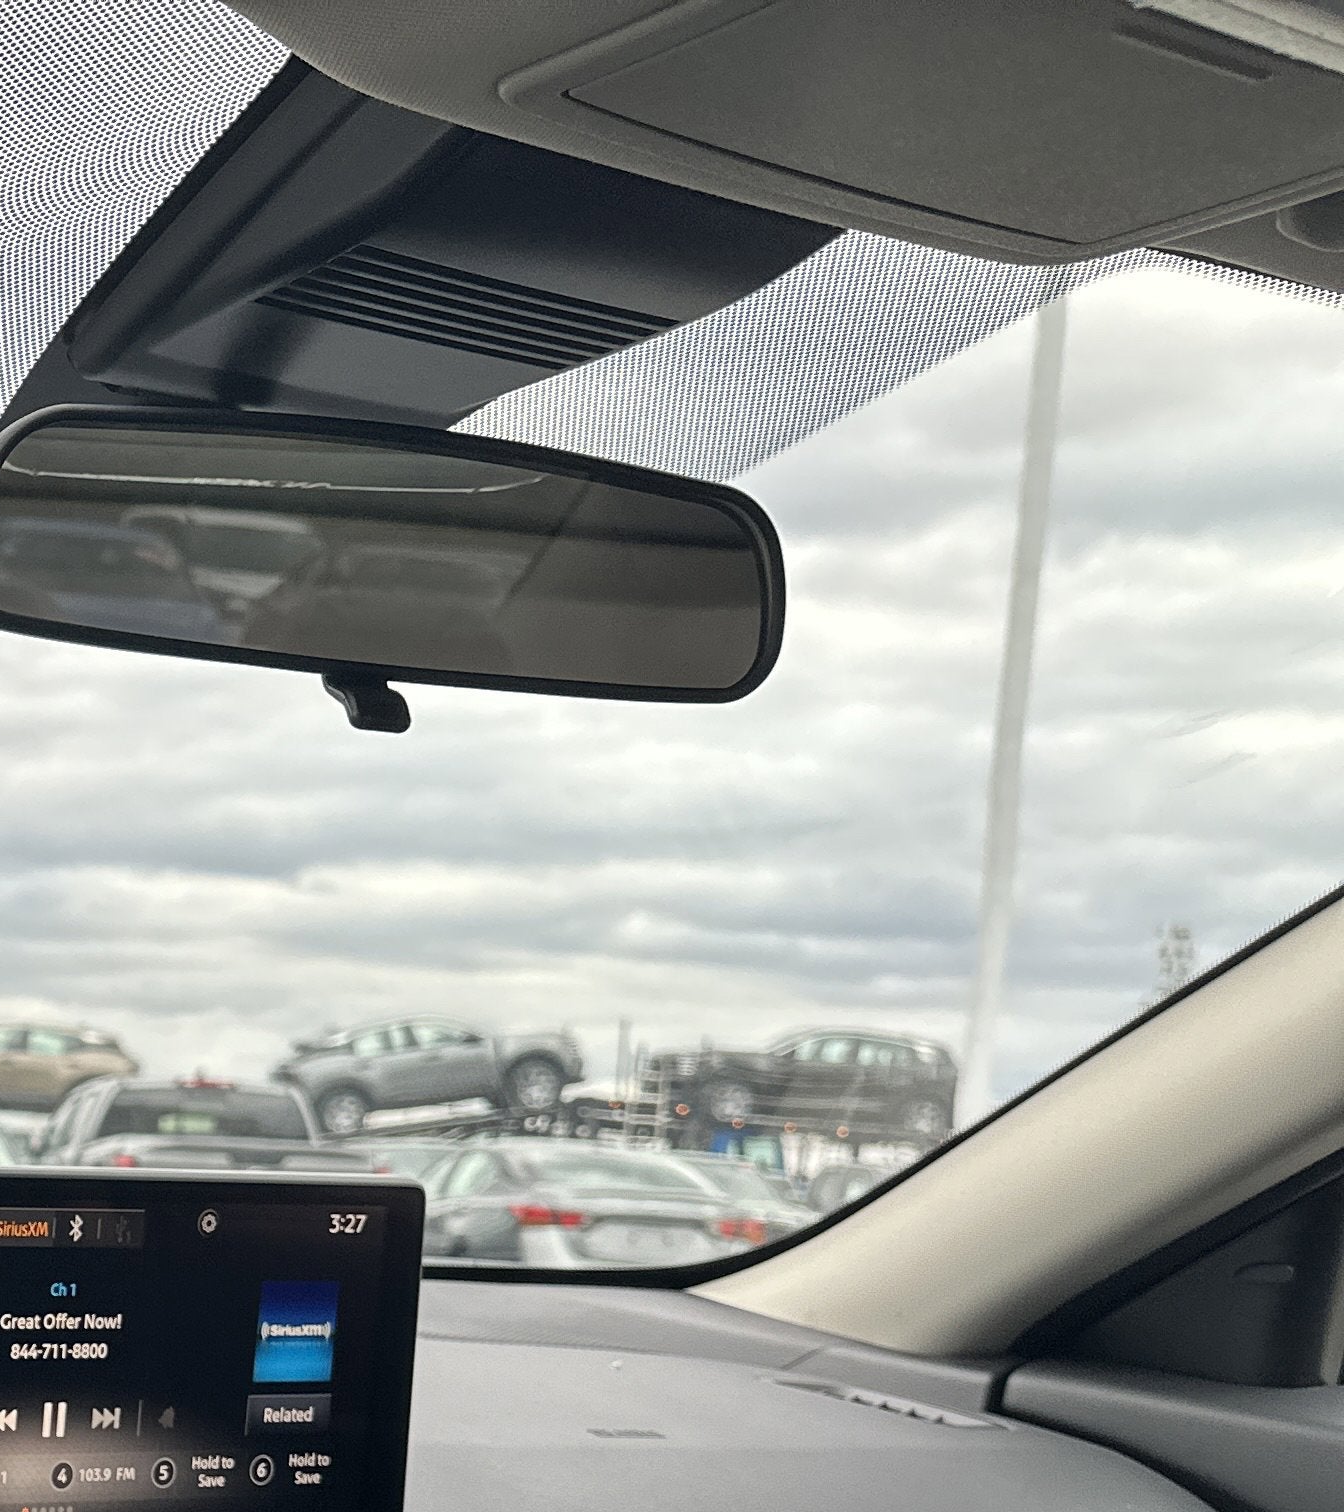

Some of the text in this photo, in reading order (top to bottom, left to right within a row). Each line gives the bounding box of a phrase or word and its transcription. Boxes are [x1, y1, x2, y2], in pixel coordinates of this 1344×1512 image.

[328, 1213, 369, 1234] 3:27
[50, 1282, 78, 1297] Ch 1
[0, 1312, 123, 1330] Great Offer Now!
[9, 1342, 109, 1360] 844-711-8800
[263, 1406, 314, 1424] Related
[158, 1454, 236, 1481] 5 Hold to
[256, 1451, 332, 1479] 6 Hold to
[0, 1470, 9, 1485] 1
[56, 1466, 137, 1484] 4 103.9 FM
[197, 1473, 227, 1488] Save
[294, 1470, 323, 1486] Save
